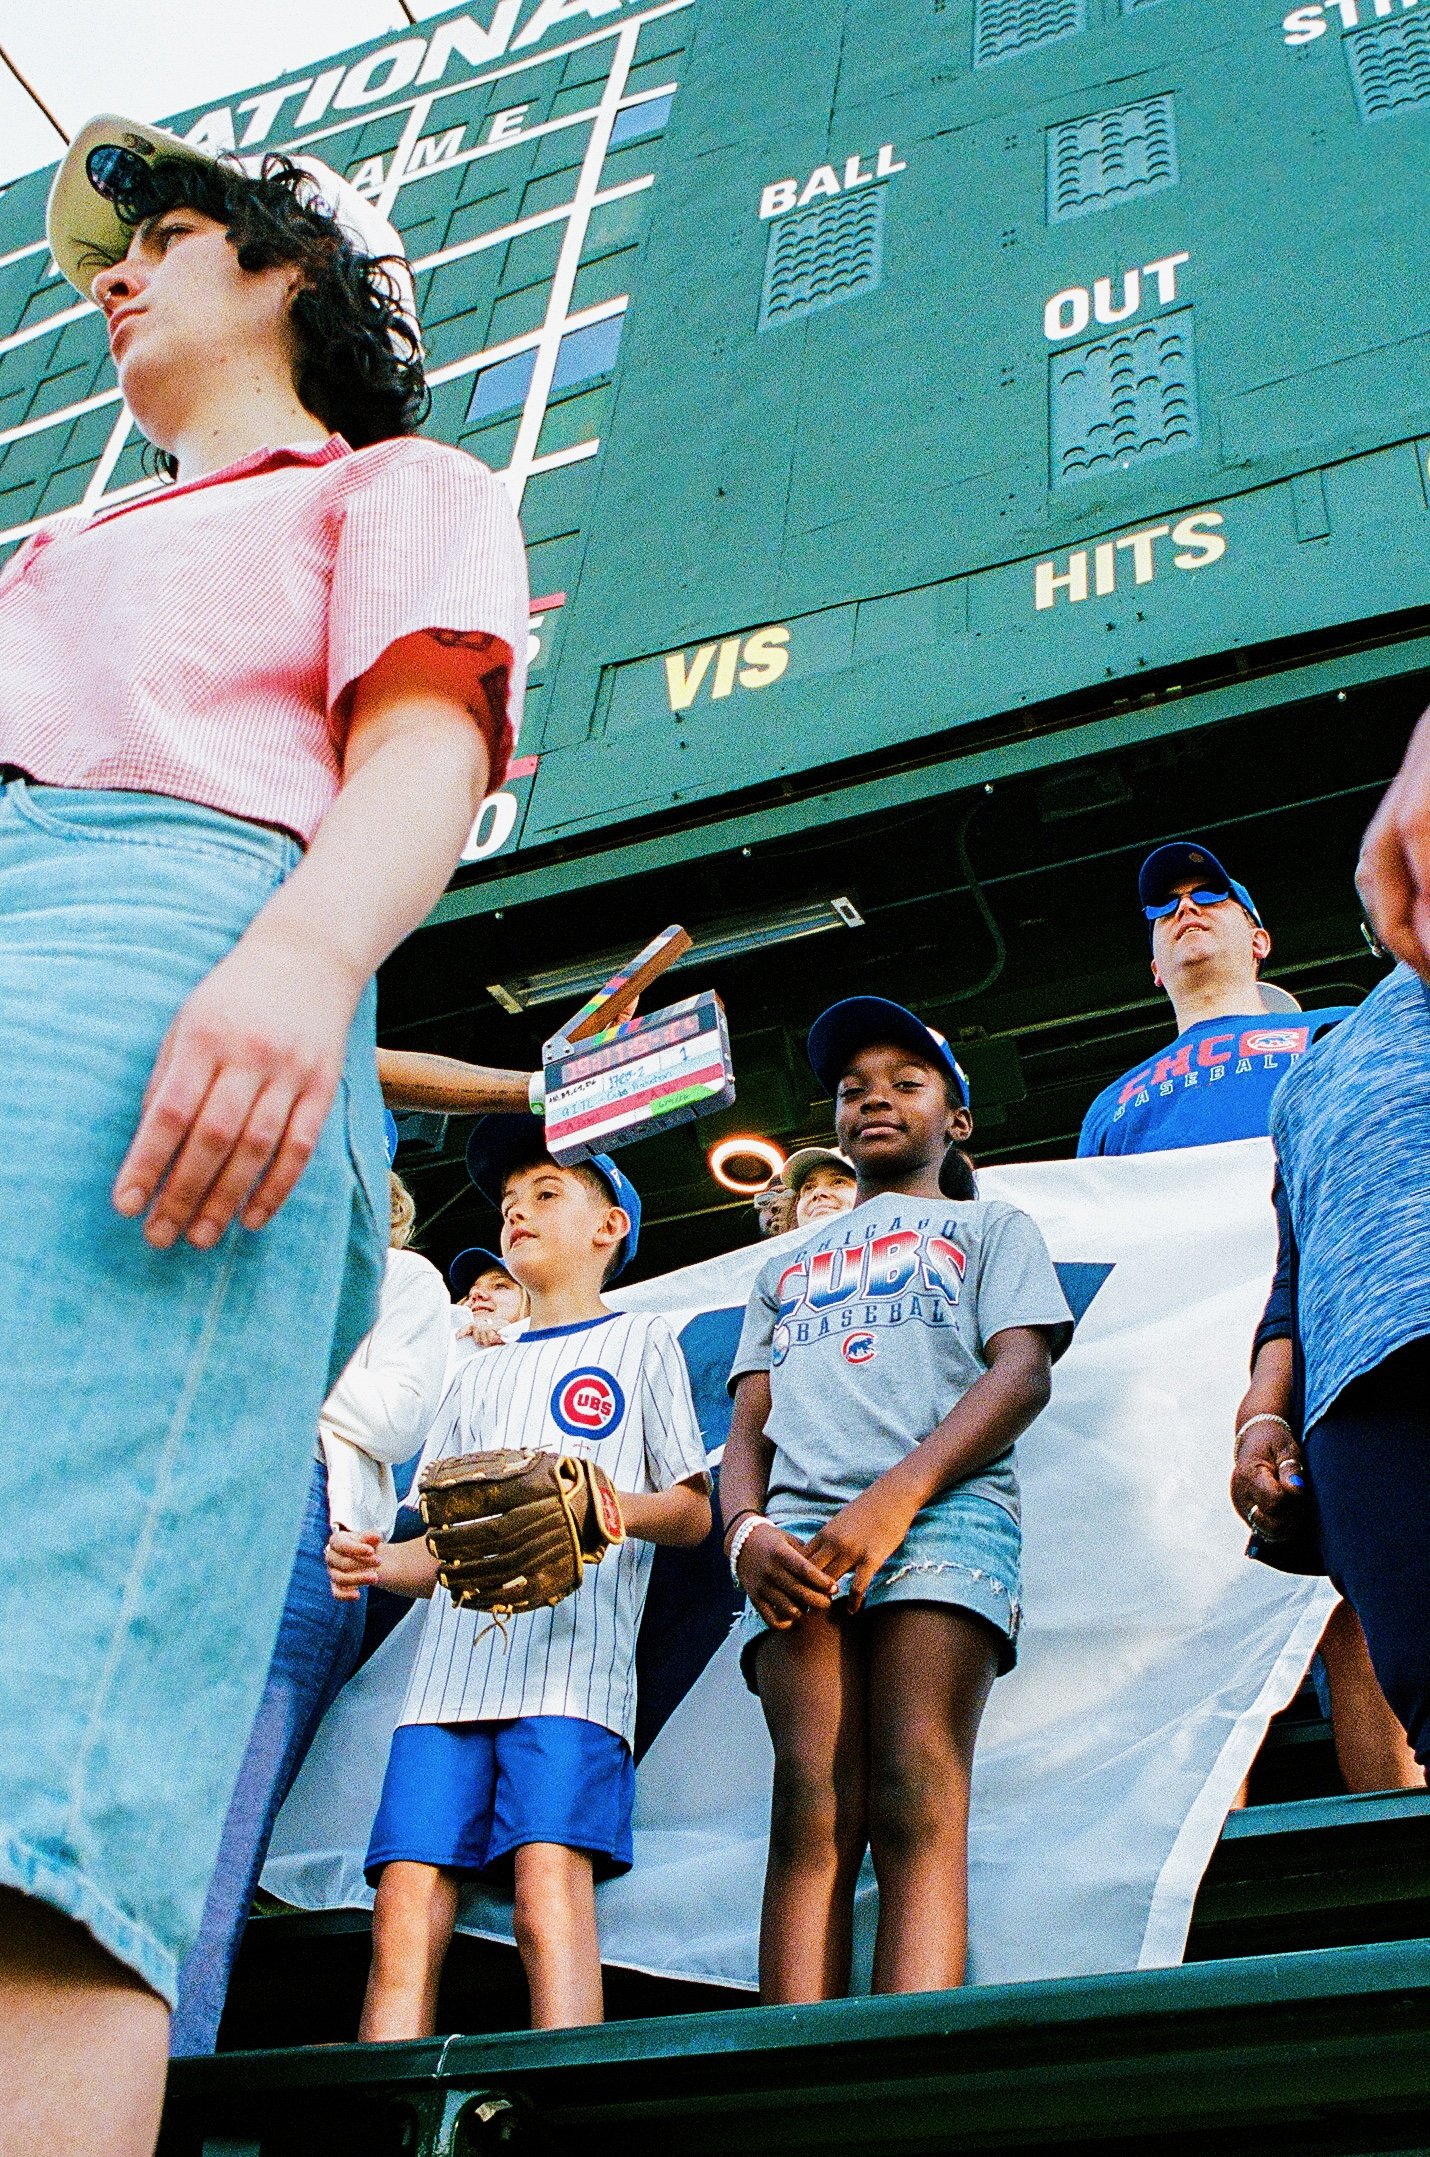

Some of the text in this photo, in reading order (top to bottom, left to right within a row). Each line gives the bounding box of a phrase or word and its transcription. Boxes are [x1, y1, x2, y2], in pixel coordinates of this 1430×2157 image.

[355, 104, 529, 191] AME
[758, 143, 906, 219] BALL
[1043, 252, 1189, 341] OUT
[1035, 512, 1227, 611] HITS
[665, 626, 791, 711] VIS
[775, 1229, 966, 1328] CUBS
[795, 1216, 958, 1264] CHICAGO
[796, 1295, 960, 1343] BASEBAL
[564, 1378, 612, 1427] CUBS
